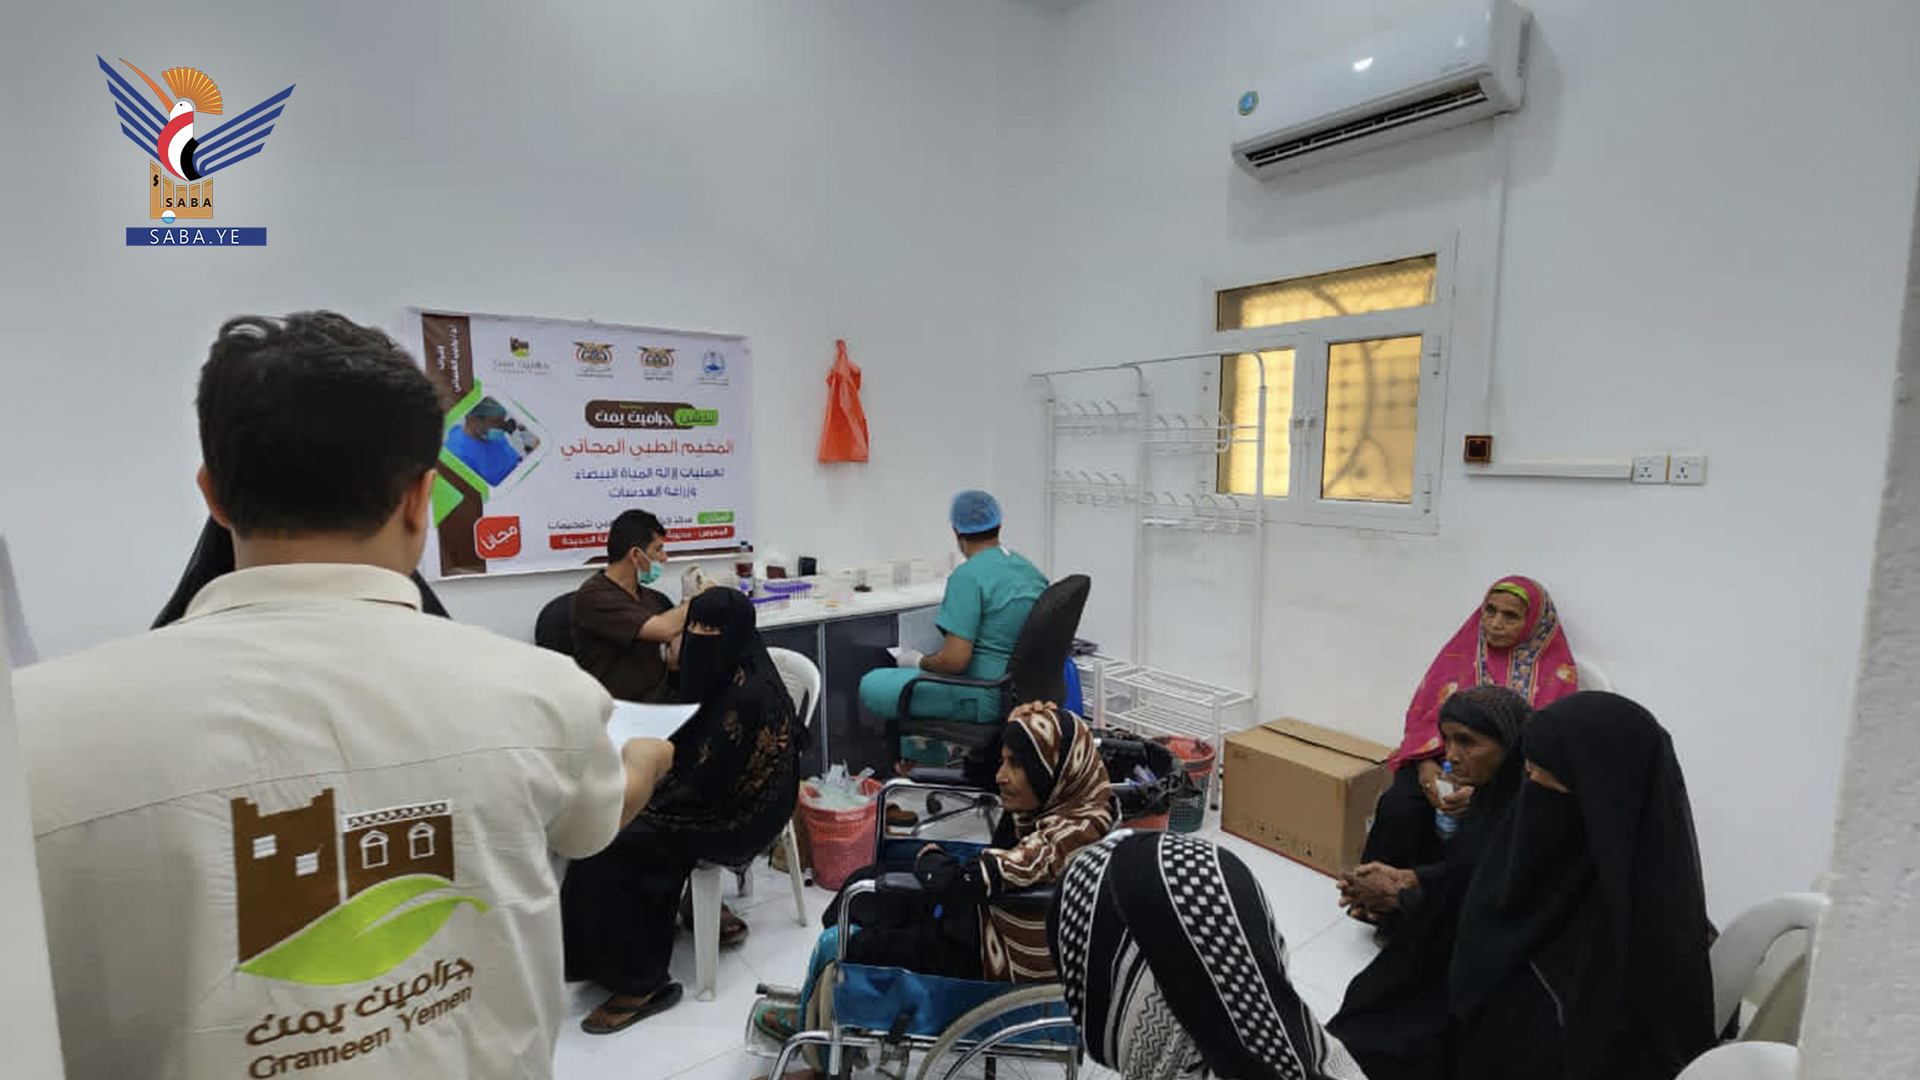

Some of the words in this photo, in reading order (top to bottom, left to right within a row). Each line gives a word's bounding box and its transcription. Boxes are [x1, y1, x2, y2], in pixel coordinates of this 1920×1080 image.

[560, 436, 626, 462] المجاني
[629, 437, 679, 462] الطبي
[682, 437, 735, 459] المخيم
[354, 956, 475, 1018] جرامين
[245, 1002, 347, 1046] يمن
[248, 1025, 392, 1080] Grameen
[397, 985, 474, 1033] Yemen
